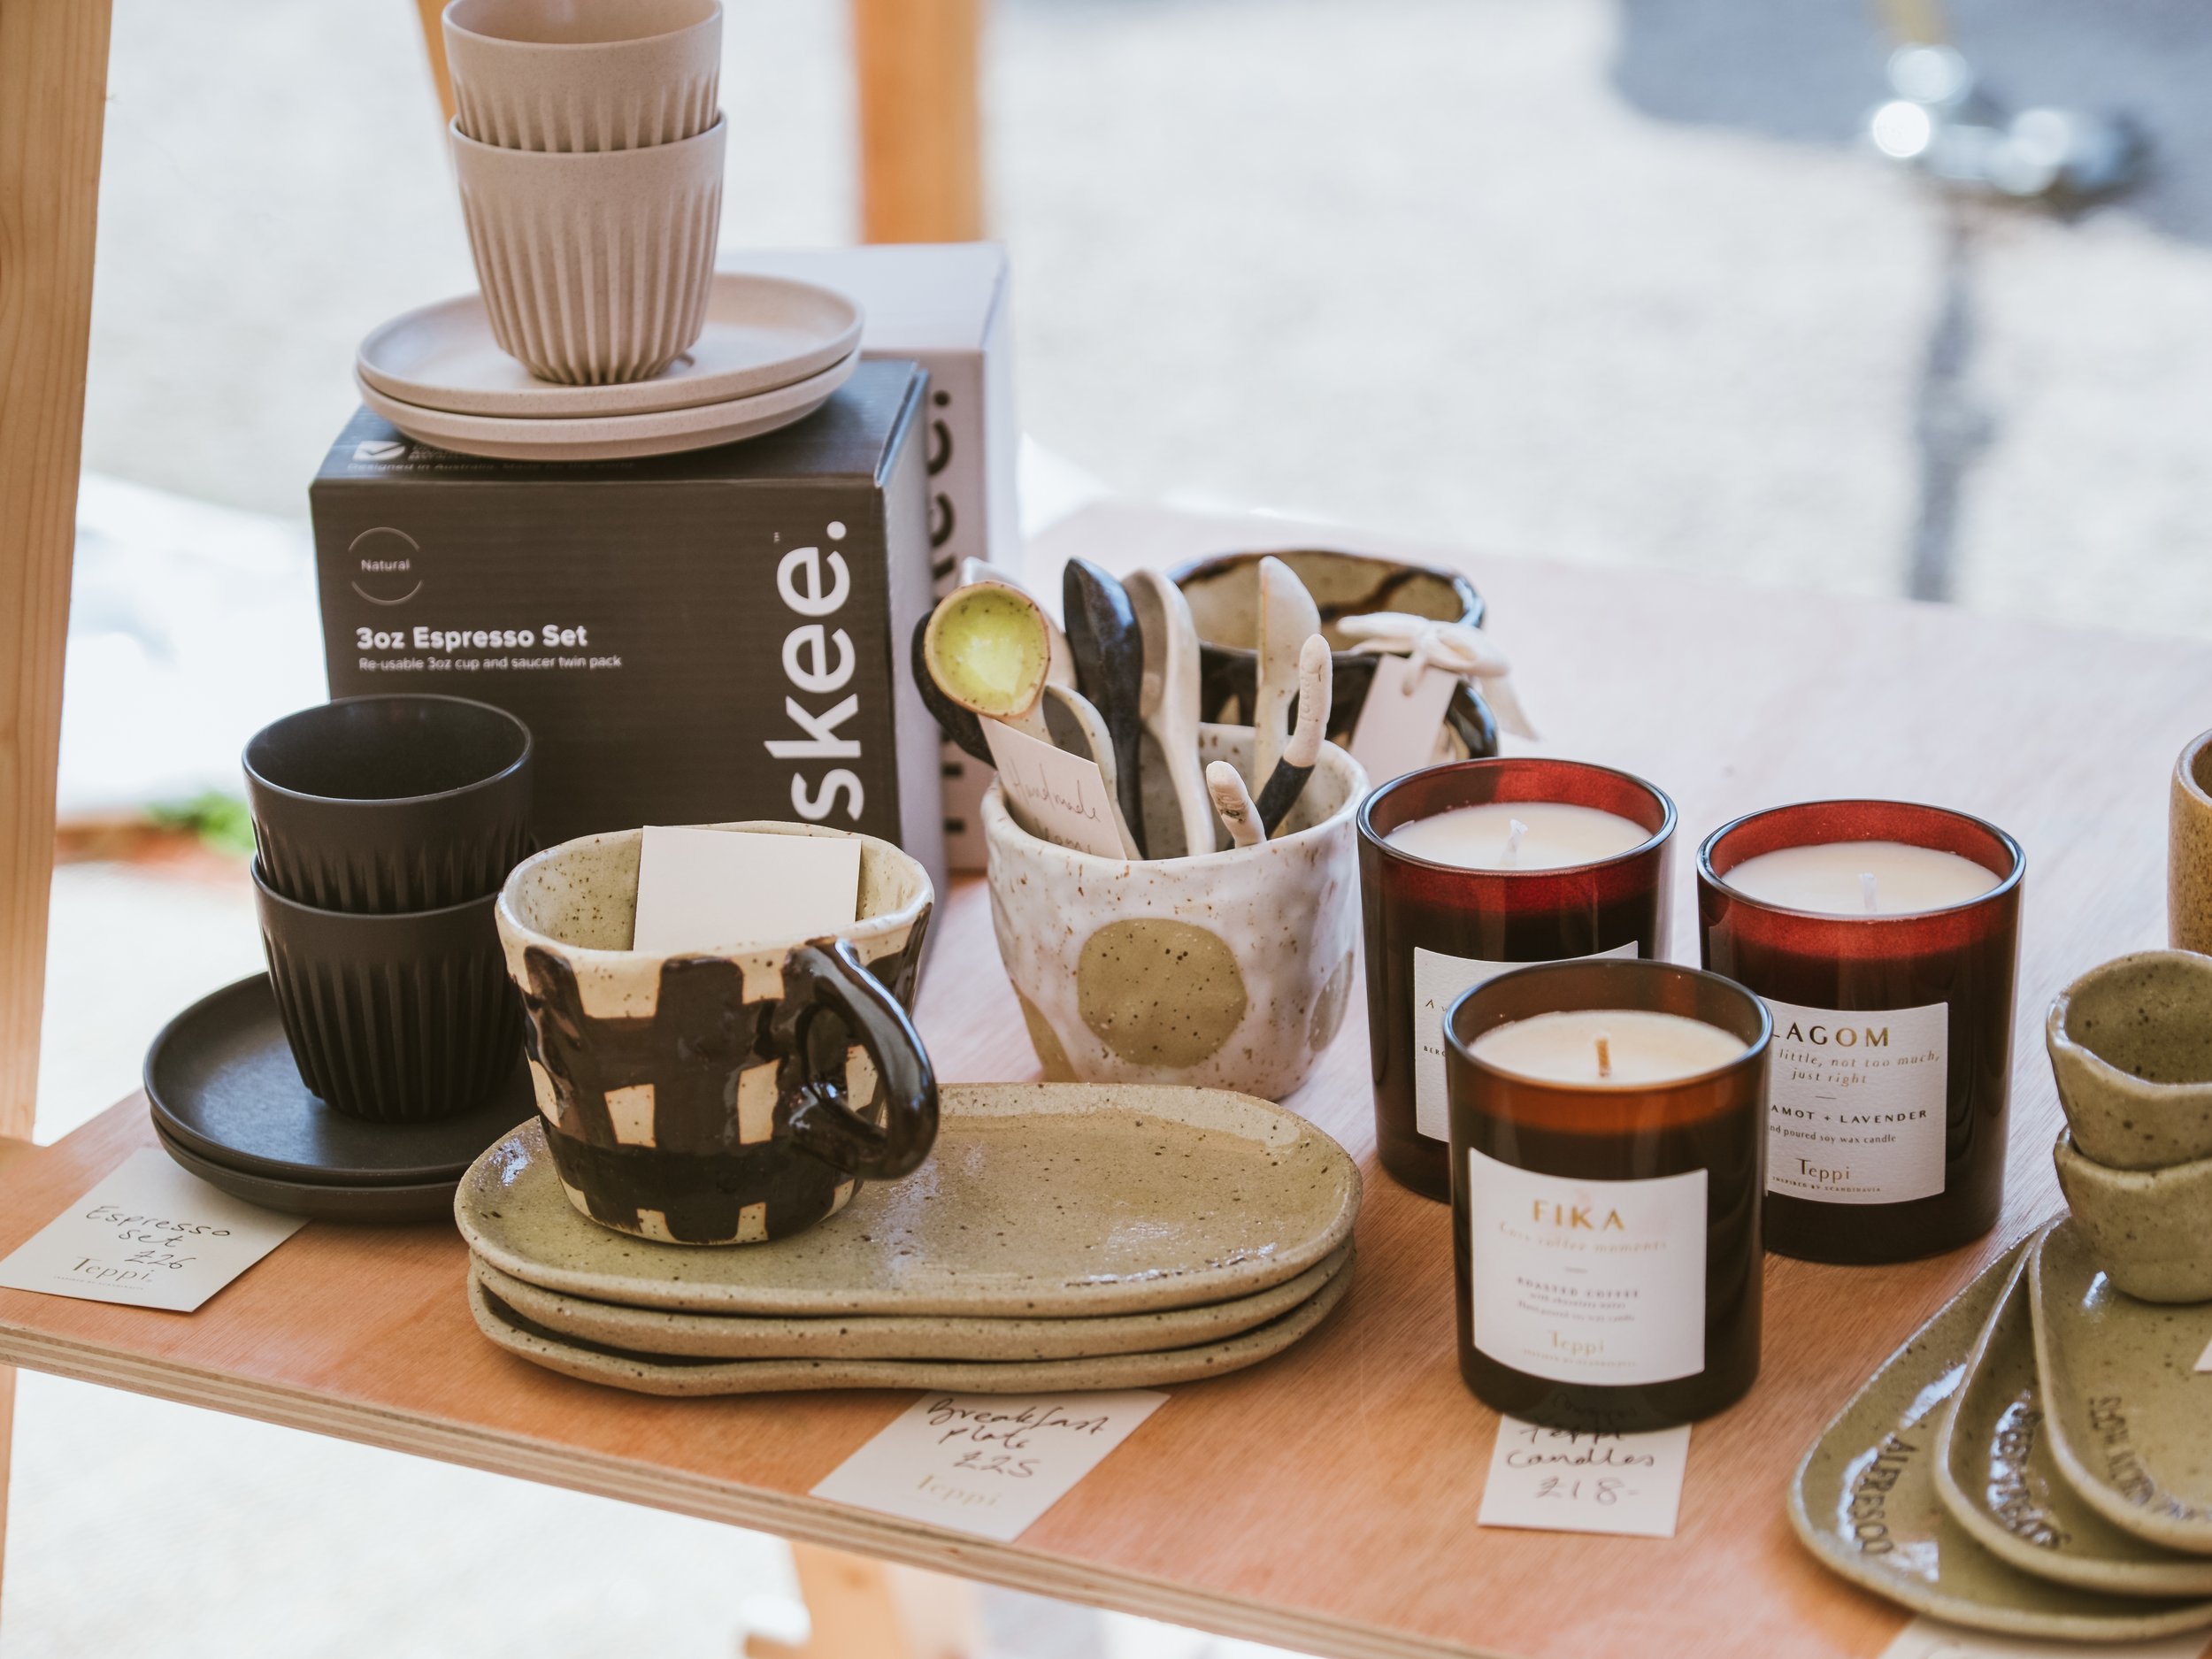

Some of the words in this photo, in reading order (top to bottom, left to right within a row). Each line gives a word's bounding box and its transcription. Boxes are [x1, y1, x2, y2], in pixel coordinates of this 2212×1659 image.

[360, 558, 411, 572] Natural
[356, 626, 405, 649] 3oz
[412, 626, 535, 653] Espresso
[541, 624, 588, 648] Set
[358, 657, 424, 671] Re-usable
[426, 657, 452, 670] 3oz
[455, 657, 480, 672] cup
[483, 657, 508, 670] and
[511, 657, 555, 670] saucer
[558, 656, 587, 669] twin
[589, 655, 622, 671] pack
[764, 520, 865, 821] skee.
[1778, 1048, 1823, 1068] little,
[1831, 1058, 1856, 1068] not
[1864, 1057, 1891, 1068] too
[1897, 1050, 1940, 1066] much,
[1791, 1067, 1821, 1081] just
[1828, 1071, 1867, 1087] right
[1770, 1104, 1816, 1120] AMOT
[1839, 1109, 1928, 1124] LAVENDER
[1770, 1125, 1781, 1133] nd
[1783, 1126, 1816, 1141] poured
[1819, 1134, 1836, 1144] soy
[1863, 1133, 1897, 1144] candle
[1772, 1176, 1808, 1188] INSPIRED
[1795, 1156, 1850, 1184] Teppi
[86, 1205, 232, 1237] Espresso
[1532, 1199, 1625, 1233] FIKA
[73, 1256, 155, 1282] Teppi
[1548, 1330, 1605, 1357] Teppi
[926, 1397, 1110, 1436] Breakfast
[915, 1474, 1004, 1507] Teppi
